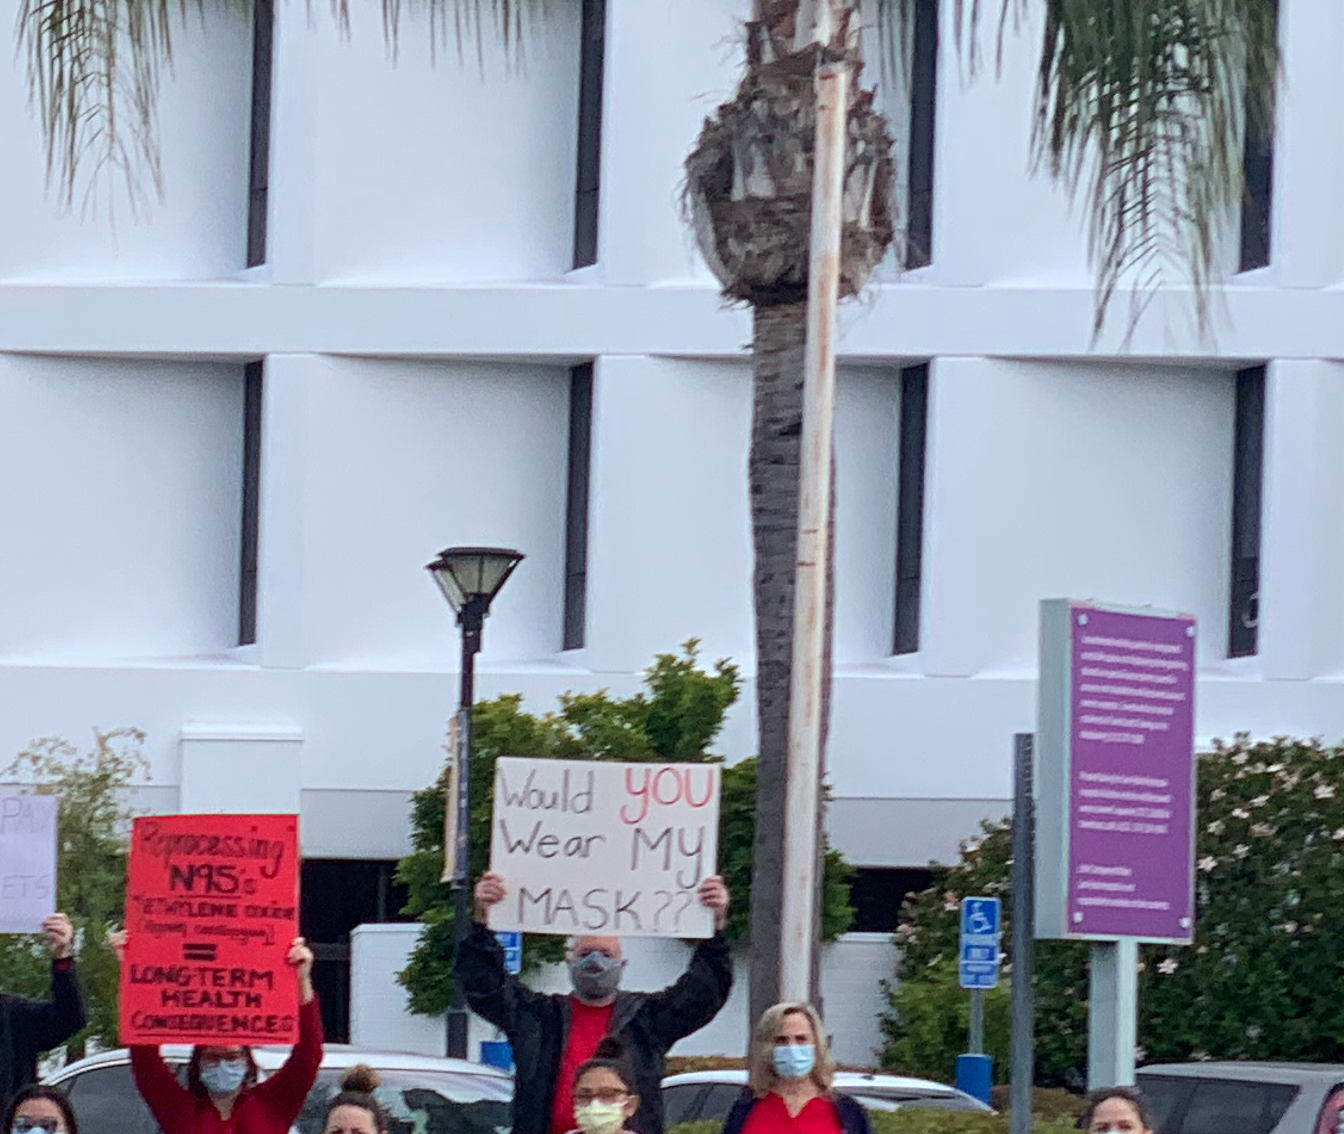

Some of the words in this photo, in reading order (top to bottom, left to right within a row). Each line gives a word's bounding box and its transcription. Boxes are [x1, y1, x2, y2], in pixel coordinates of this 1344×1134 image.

[497, 767, 596, 815] Would
[499, 820, 606, 859] Wear
[161, 989, 262, 1009] HEALTH
